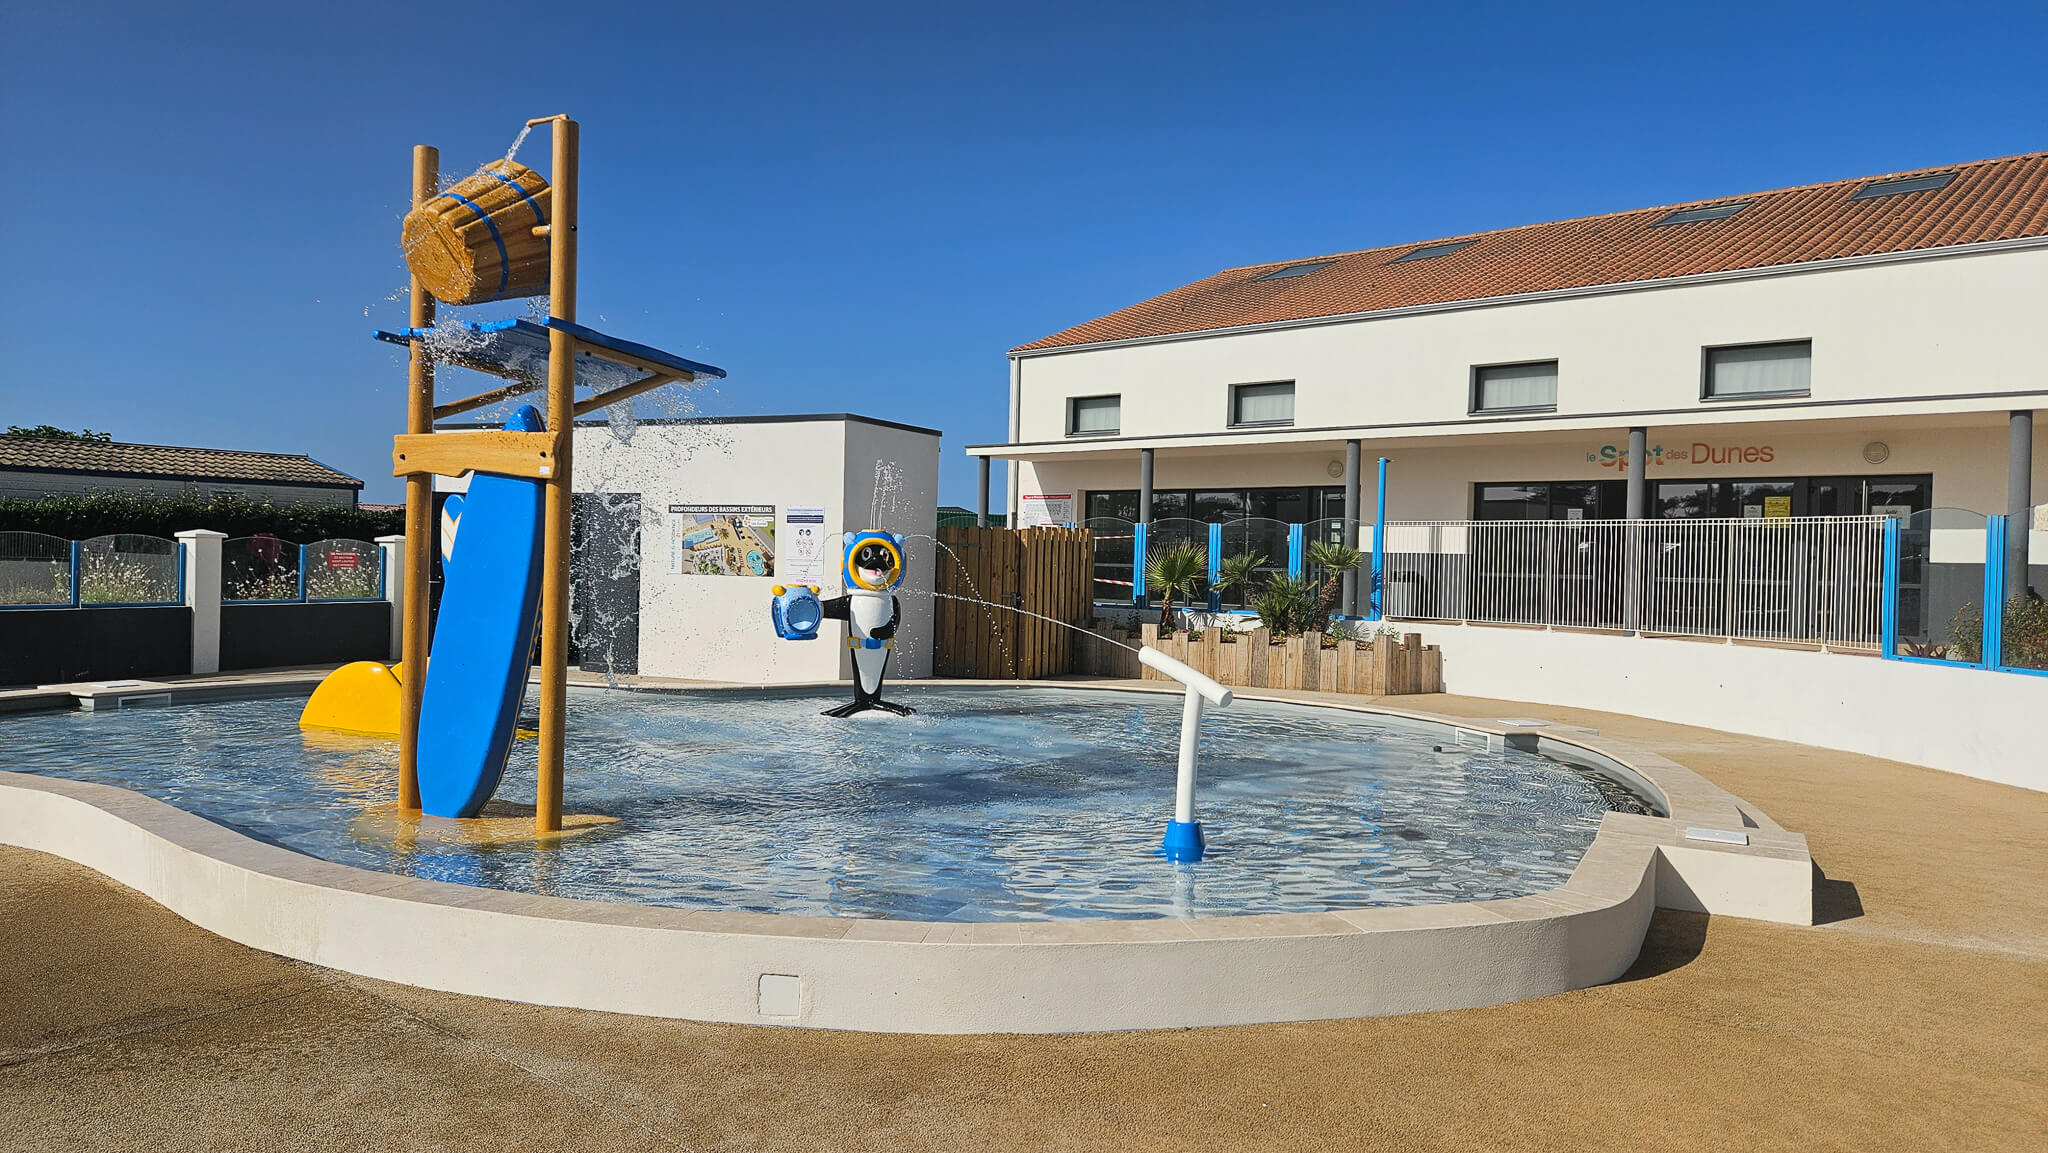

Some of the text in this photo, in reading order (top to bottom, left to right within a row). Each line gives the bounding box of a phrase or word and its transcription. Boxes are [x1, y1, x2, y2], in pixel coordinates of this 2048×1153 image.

[1586, 451, 1596, 463] le
[1665, 449, 1688, 461] des
[1691, 443, 1775, 465] Dunes
[741, 505, 772, 513] EXTÉRIEURS
